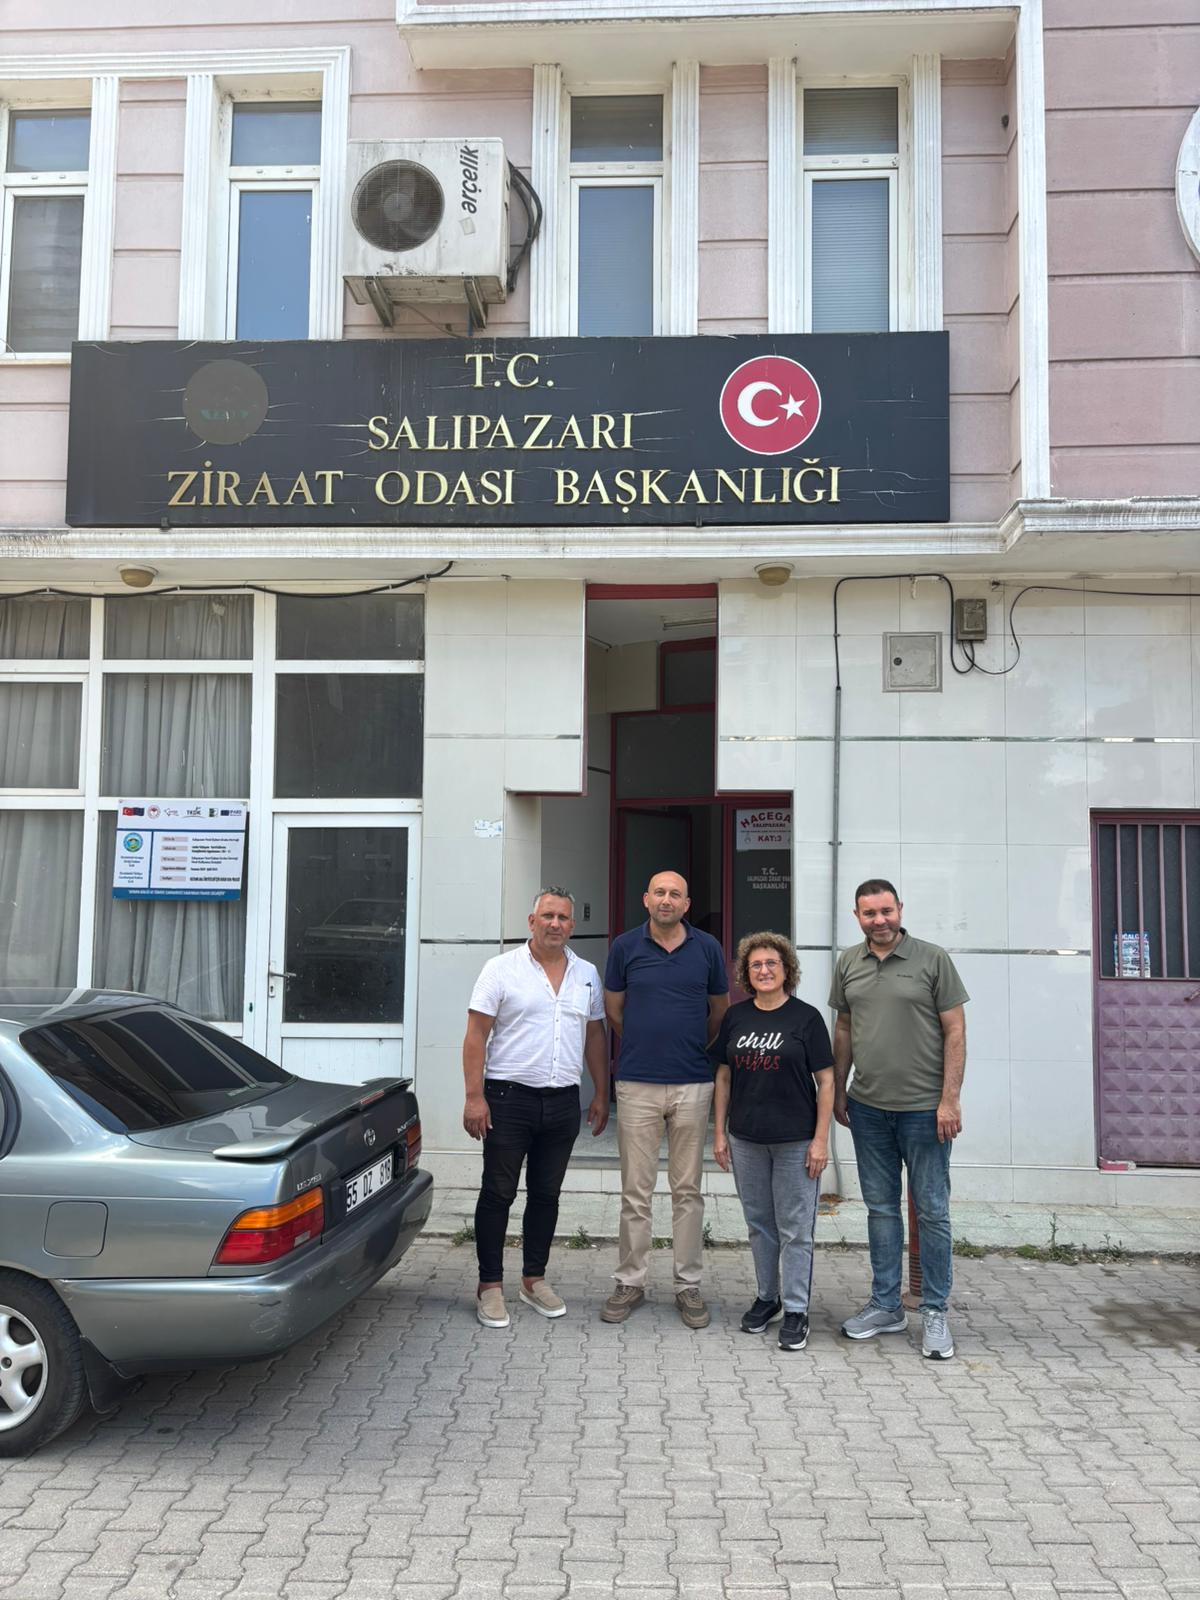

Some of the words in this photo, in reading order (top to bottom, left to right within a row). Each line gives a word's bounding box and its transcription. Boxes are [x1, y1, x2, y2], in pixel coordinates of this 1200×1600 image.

[460, 145, 482, 214] arçelik
[465, 351, 554, 390] T.C.
[367, 413, 635, 452] SALIPAZARI
[167, 459, 345, 508] ZİRAAT
[375, 469, 514, 508] ODASI
[555, 457, 842, 514] BAŞKANLIĞI
[736, 1031, 784, 1050] chill
[735, 1050, 781, 1072] vibes
[346, 1181, 358, 1209] 55
[363, 1171, 373, 1197] DZ
